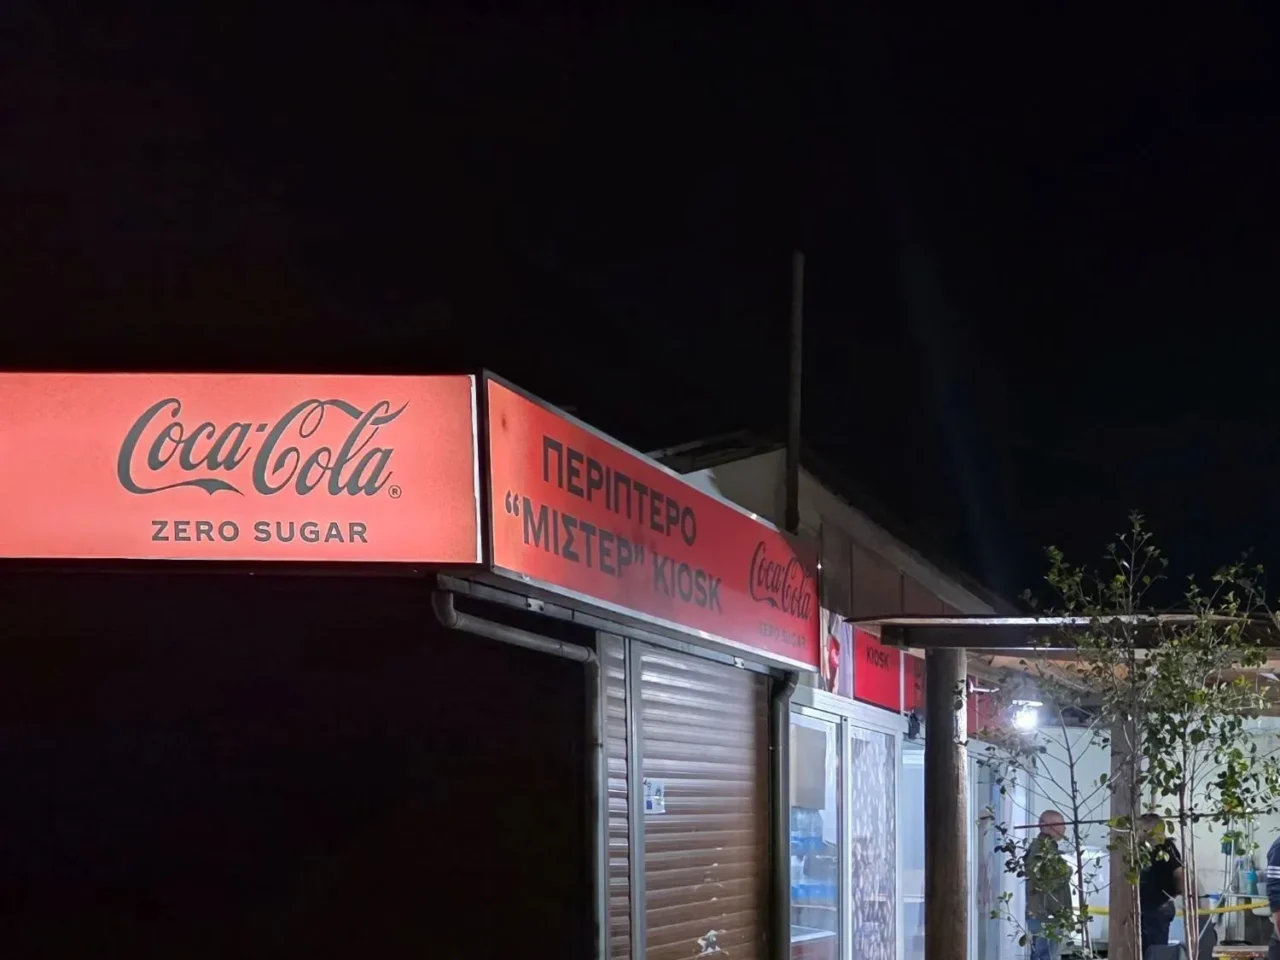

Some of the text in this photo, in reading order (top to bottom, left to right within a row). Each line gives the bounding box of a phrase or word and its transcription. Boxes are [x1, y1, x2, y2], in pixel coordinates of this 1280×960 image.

[542, 435, 697, 546] ΠΕΡΙΠΤΕΡΟ
[151, 520, 369, 544] ZERO SUGAR
[652, 552, 722, 615] KIOSK
[866, 645, 891, 670] KIOSK
